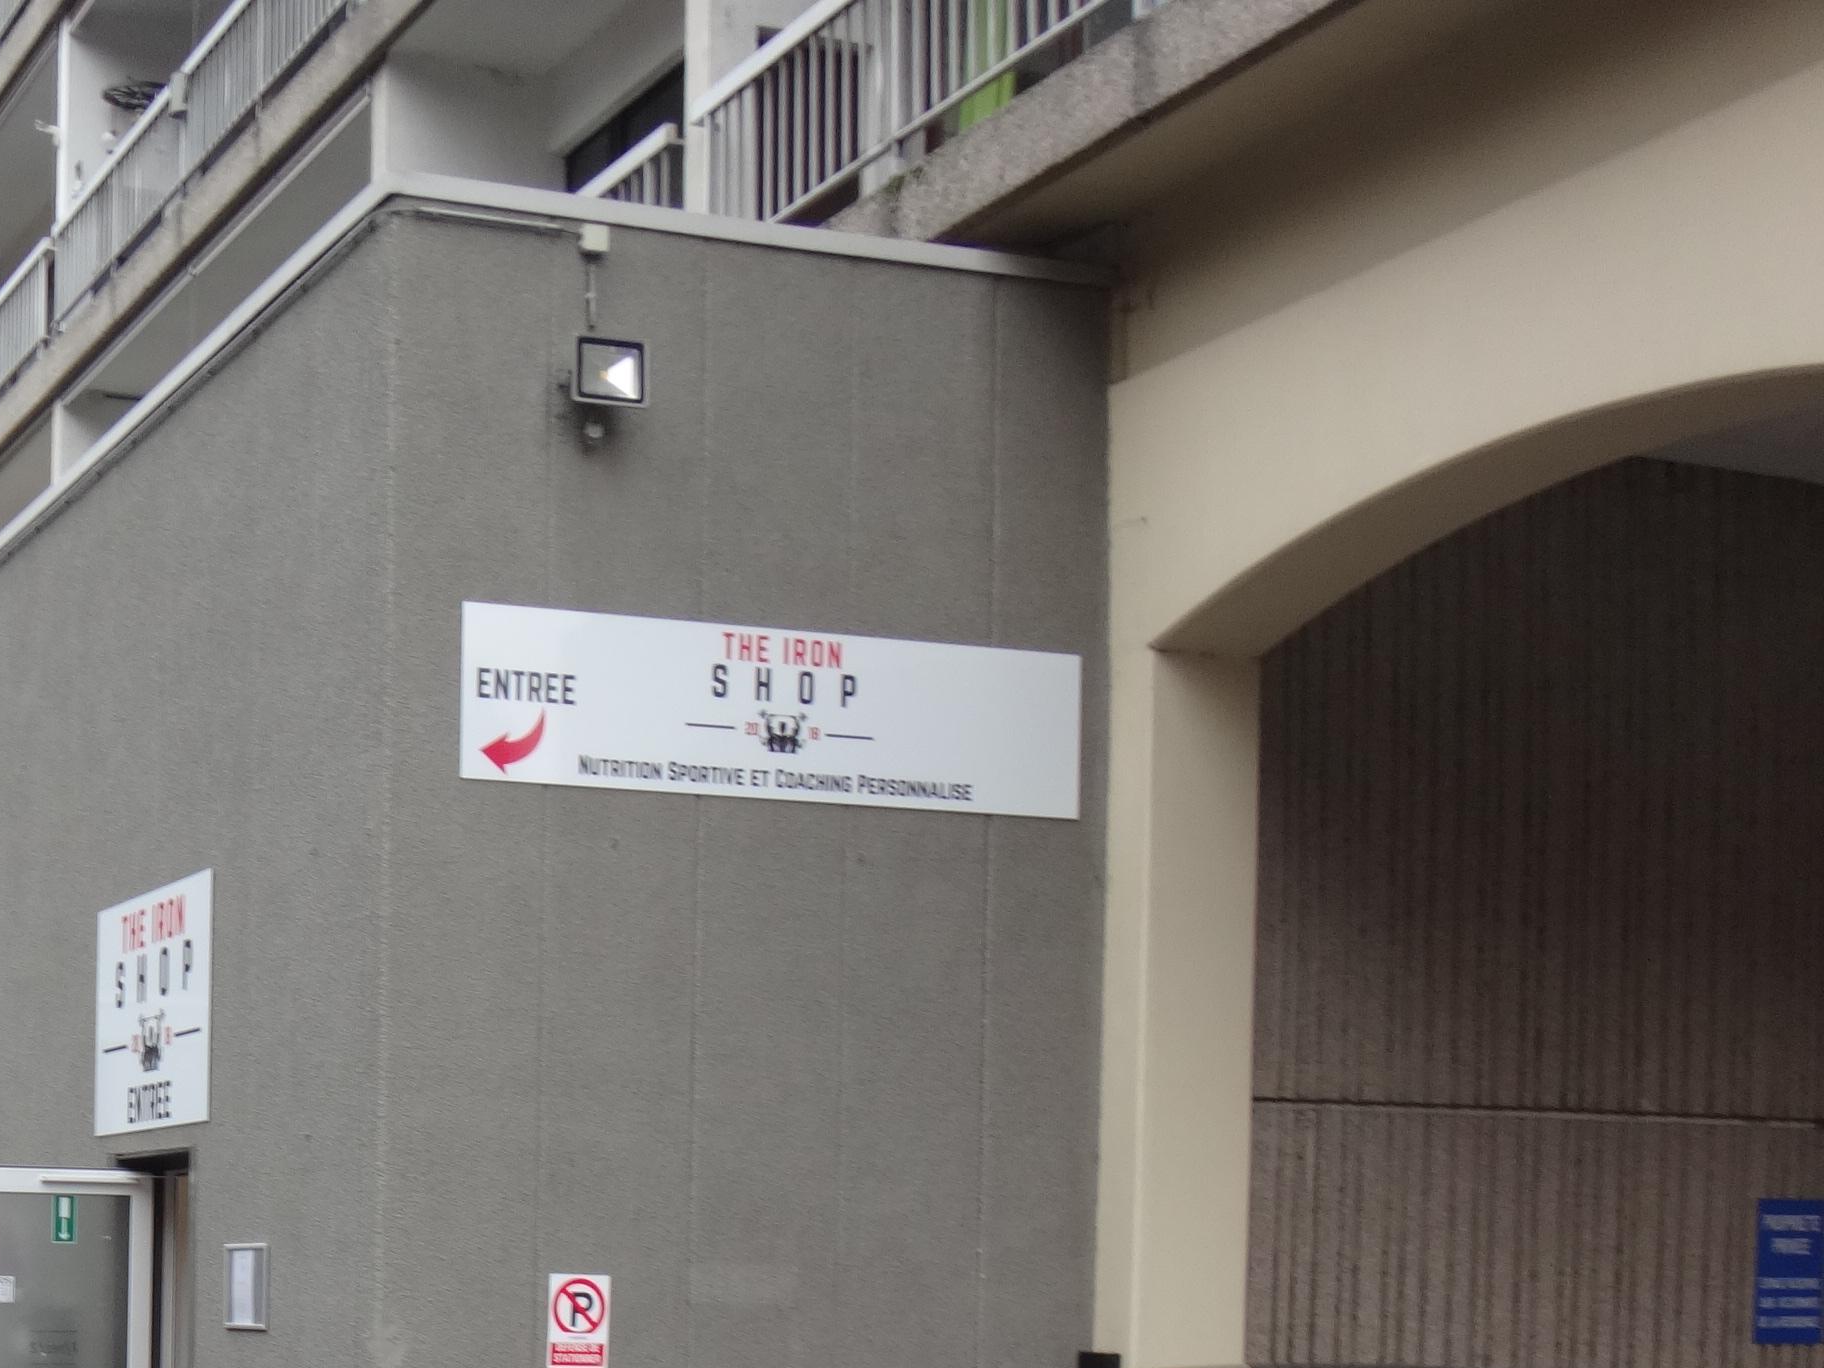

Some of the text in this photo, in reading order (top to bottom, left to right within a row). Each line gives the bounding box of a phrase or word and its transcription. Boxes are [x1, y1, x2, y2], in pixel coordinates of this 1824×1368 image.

[722, 632, 842, 668] THE IRON
[476, 667, 577, 706] ENTREE
[711, 663, 857, 708] SHOP
[750, 768, 770, 788] ET
[121, 895, 187, 953] THE IRON
[115, 939, 193, 1009] SHOP
[127, 1080, 171, 1124] ENTREE
